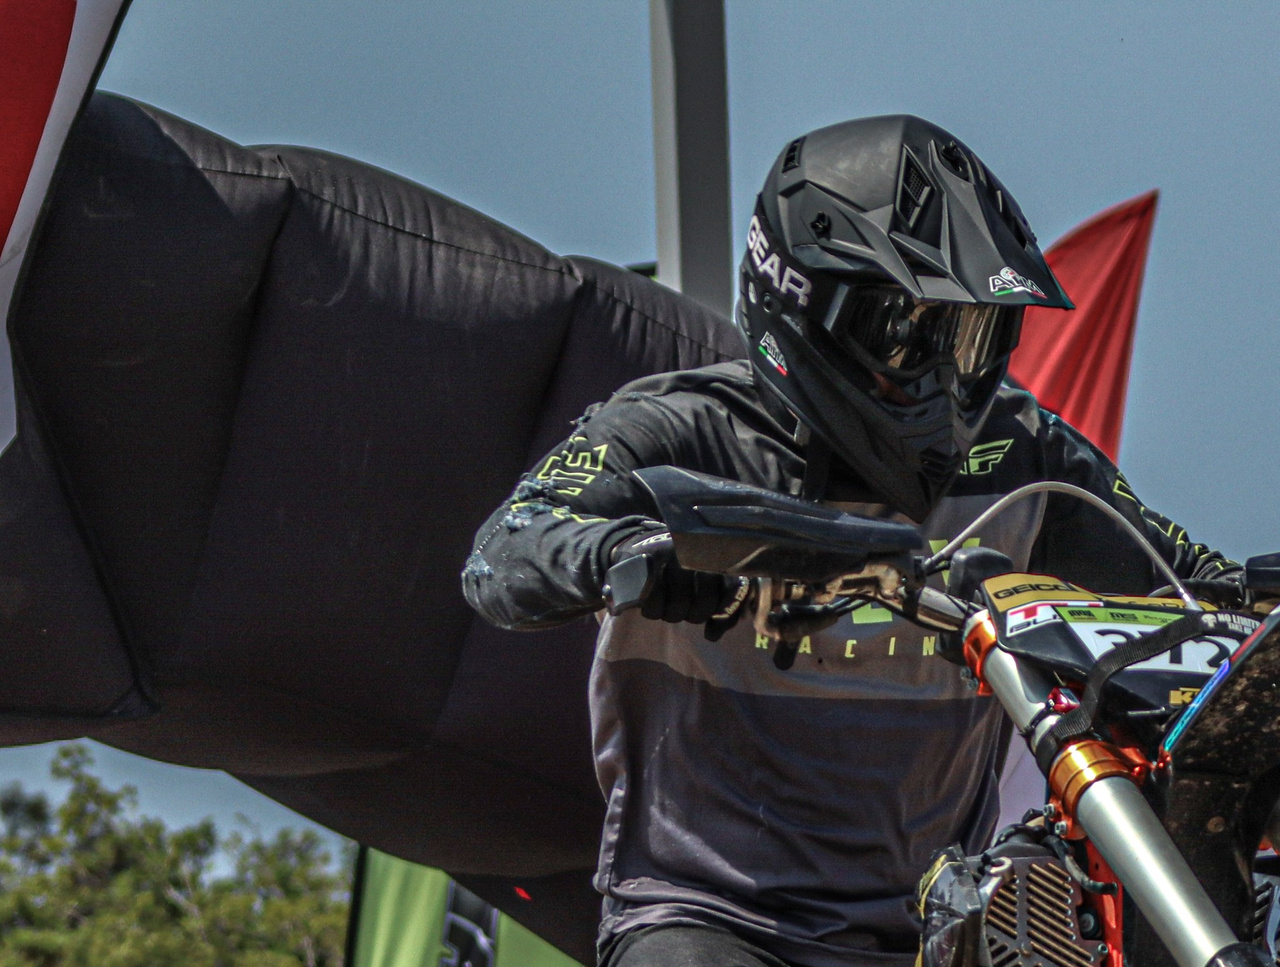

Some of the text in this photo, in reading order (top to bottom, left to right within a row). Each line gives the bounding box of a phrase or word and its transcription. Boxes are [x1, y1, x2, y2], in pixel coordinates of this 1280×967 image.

[747, 215, 812, 306] GEAR
[755, 632, 936, 658] RACIN
[1169, 687, 1202, 706] KT
